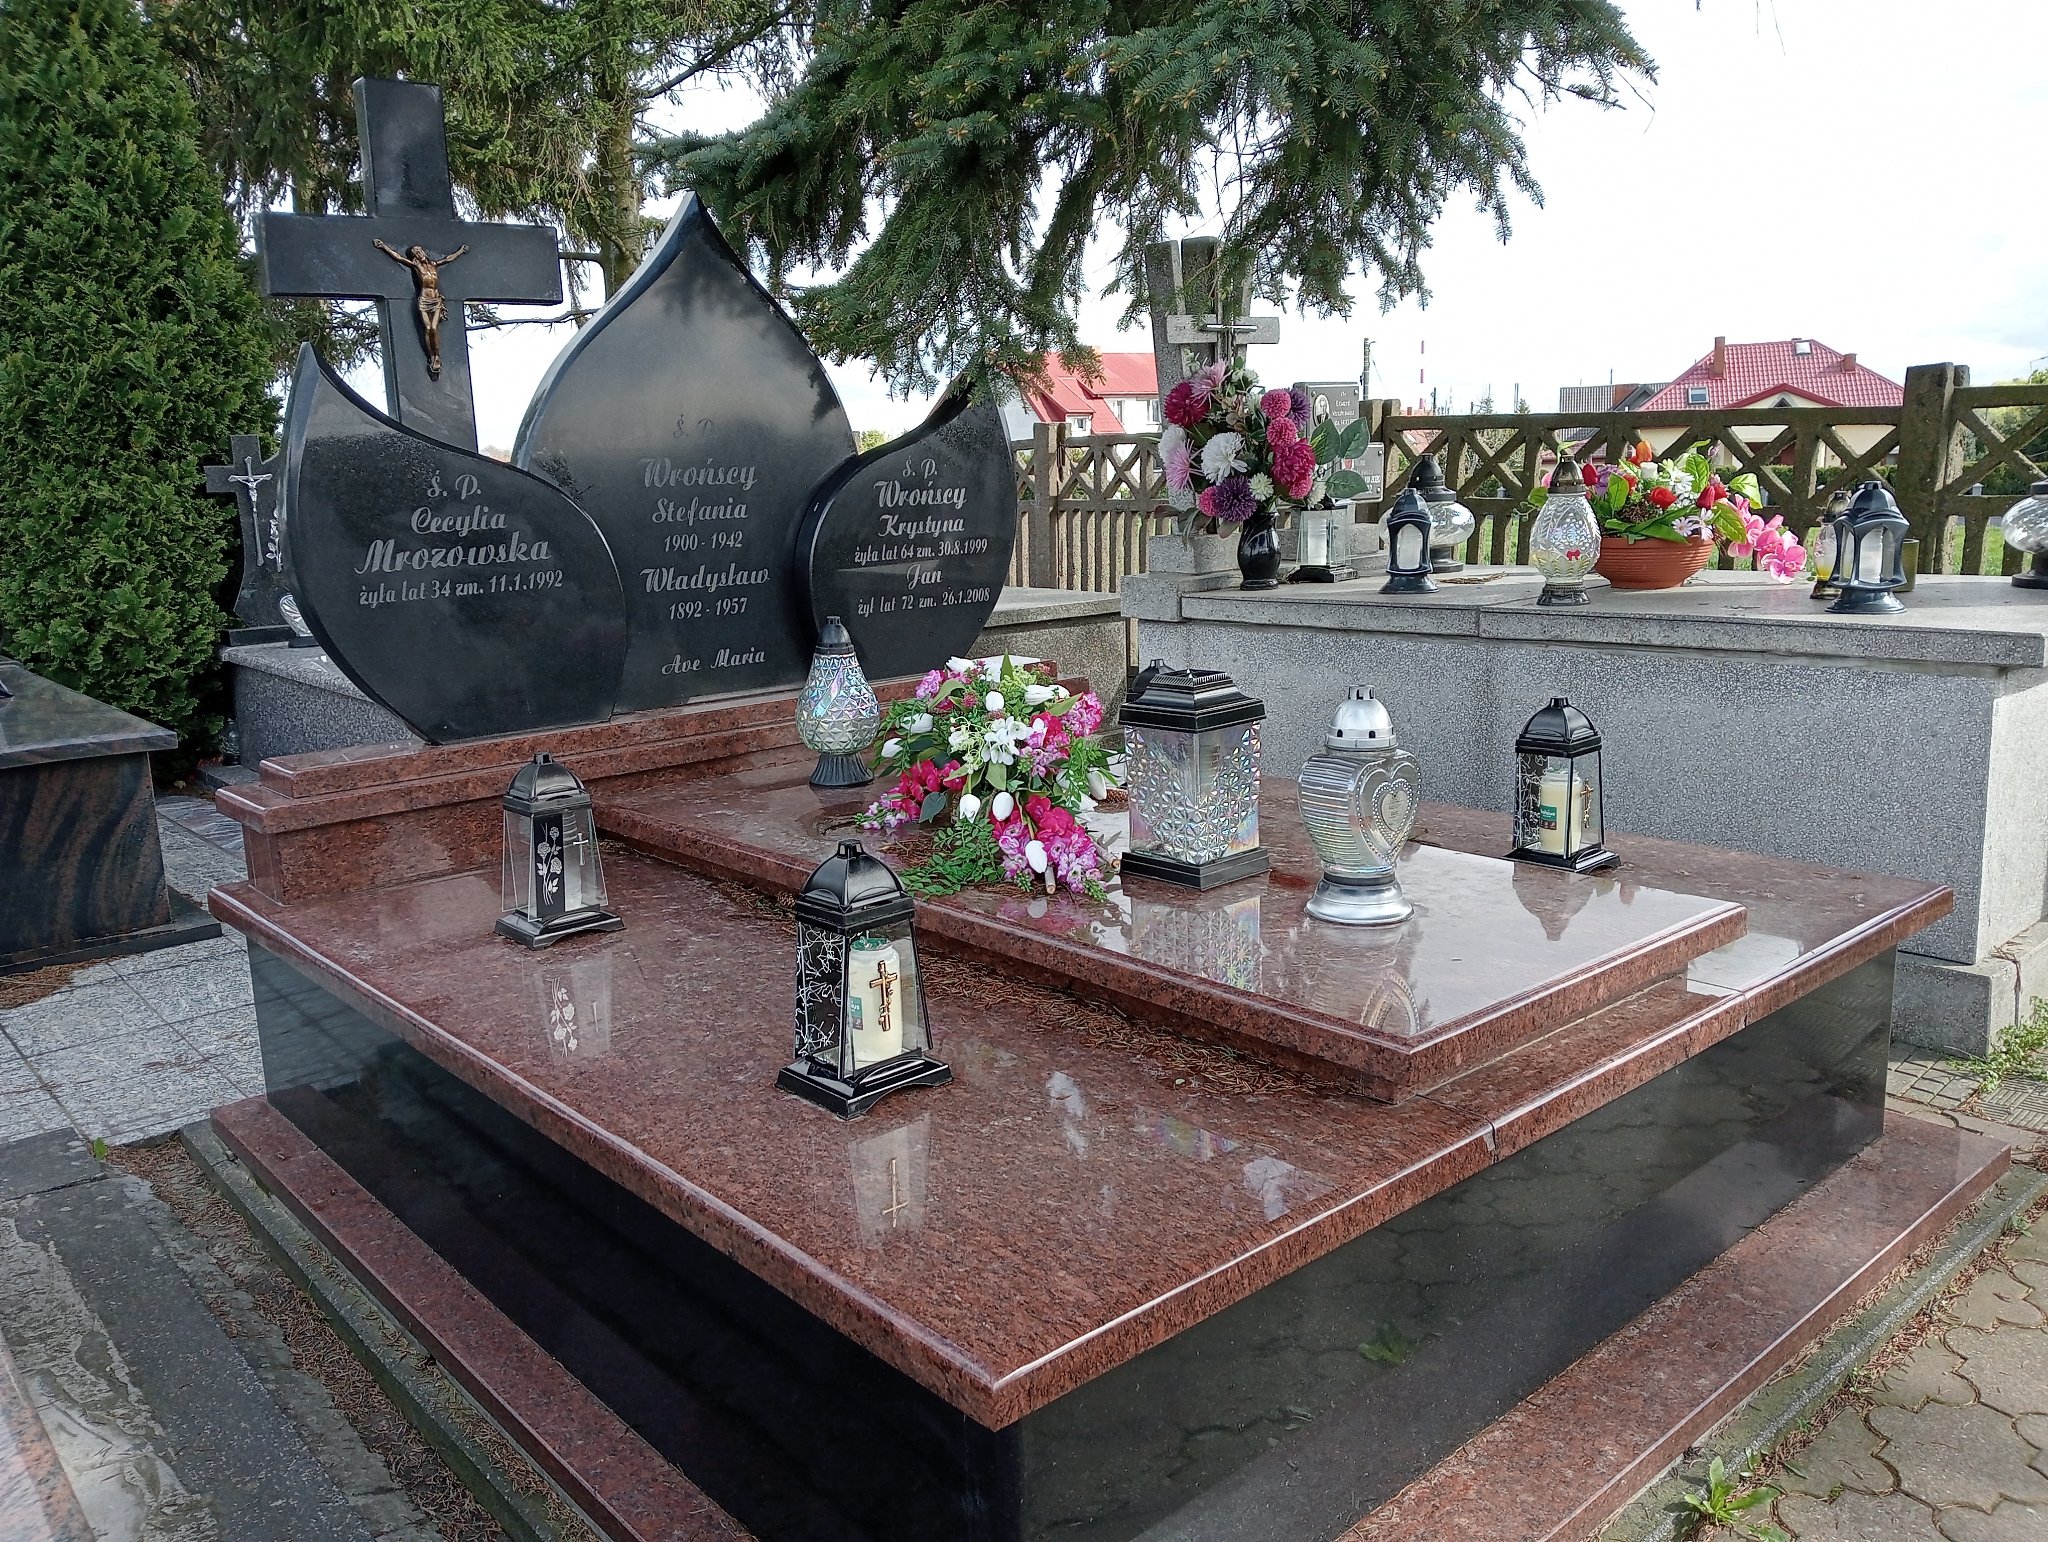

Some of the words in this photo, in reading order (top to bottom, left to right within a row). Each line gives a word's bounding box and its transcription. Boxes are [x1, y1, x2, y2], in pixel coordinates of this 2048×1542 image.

[639, 457, 759, 491] Wrońscy
[920, 458, 938, 480] P.
[455, 473, 482, 500] P.
[873, 480, 967, 510] Wrońscy
[411, 504, 508, 537] Cecylia
[652, 496, 748, 527] Stefania
[664, 533, 698, 552] 1900
[711, 530, 743, 549] 1942
[877, 514, 965, 540] Krystyna
[353, 531, 552, 575] Mrozowska
[854, 545, 879, 566] żyła
[882, 544, 898, 561] lat
[901, 543, 914, 559] 64
[916, 546, 935, 558] zm.
[938, 538, 988, 557] 30.8.1999
[359, 583, 397, 609] żyła
[401, 581, 427, 602] lat
[430, 579, 451, 599] 34
[455, 581, 484, 597] zm.
[489, 569, 564, 593] 11.1.1992
[640, 562, 770, 593] Władysław
[906, 564, 943, 590] Jan
[669, 600, 702, 620] 1892
[715, 597, 748, 616] 1957
[880, 595, 896, 613] lat
[902, 594, 914, 610] 72
[918, 597, 937, 609] zm.
[942, 587, 991, 606] 26.1.2008
[661, 654, 701, 675] Ave
[710, 647, 766, 669] Maria
